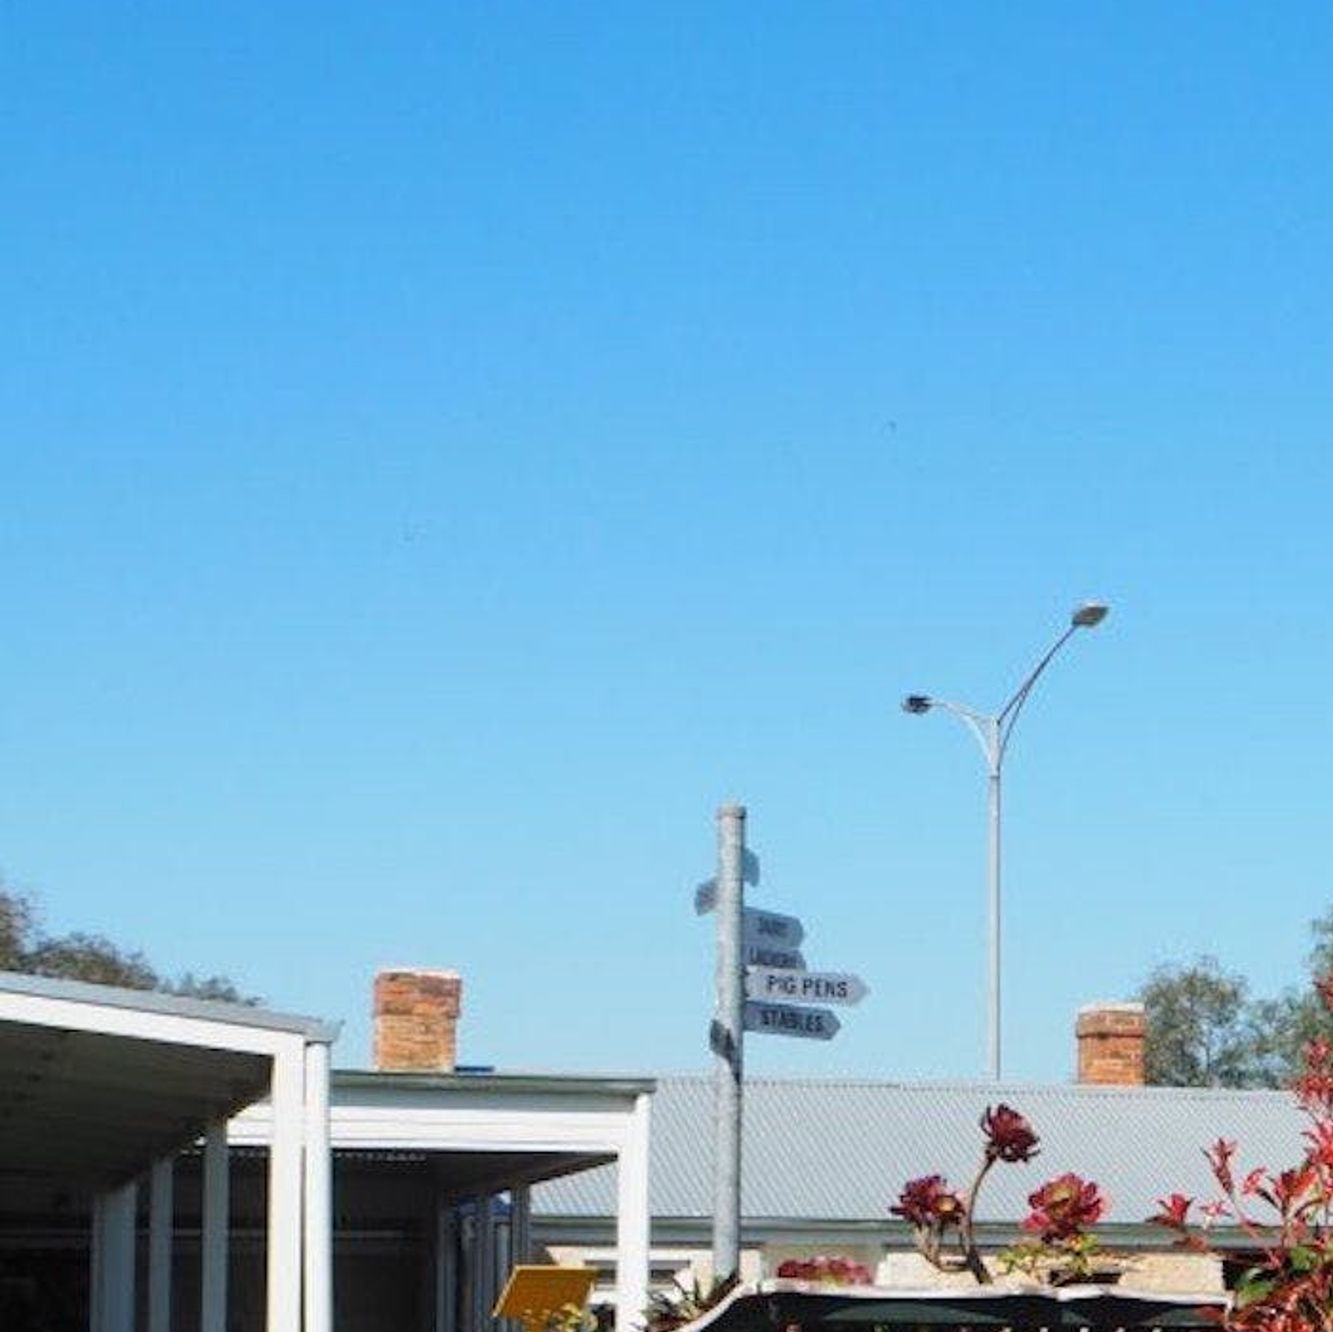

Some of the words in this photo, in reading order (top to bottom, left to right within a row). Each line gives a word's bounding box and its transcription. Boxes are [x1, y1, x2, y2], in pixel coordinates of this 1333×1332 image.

[767, 974, 797, 995] PIG
[803, 978, 848, 999] PENS
[761, 1009, 823, 1033] STABLES
